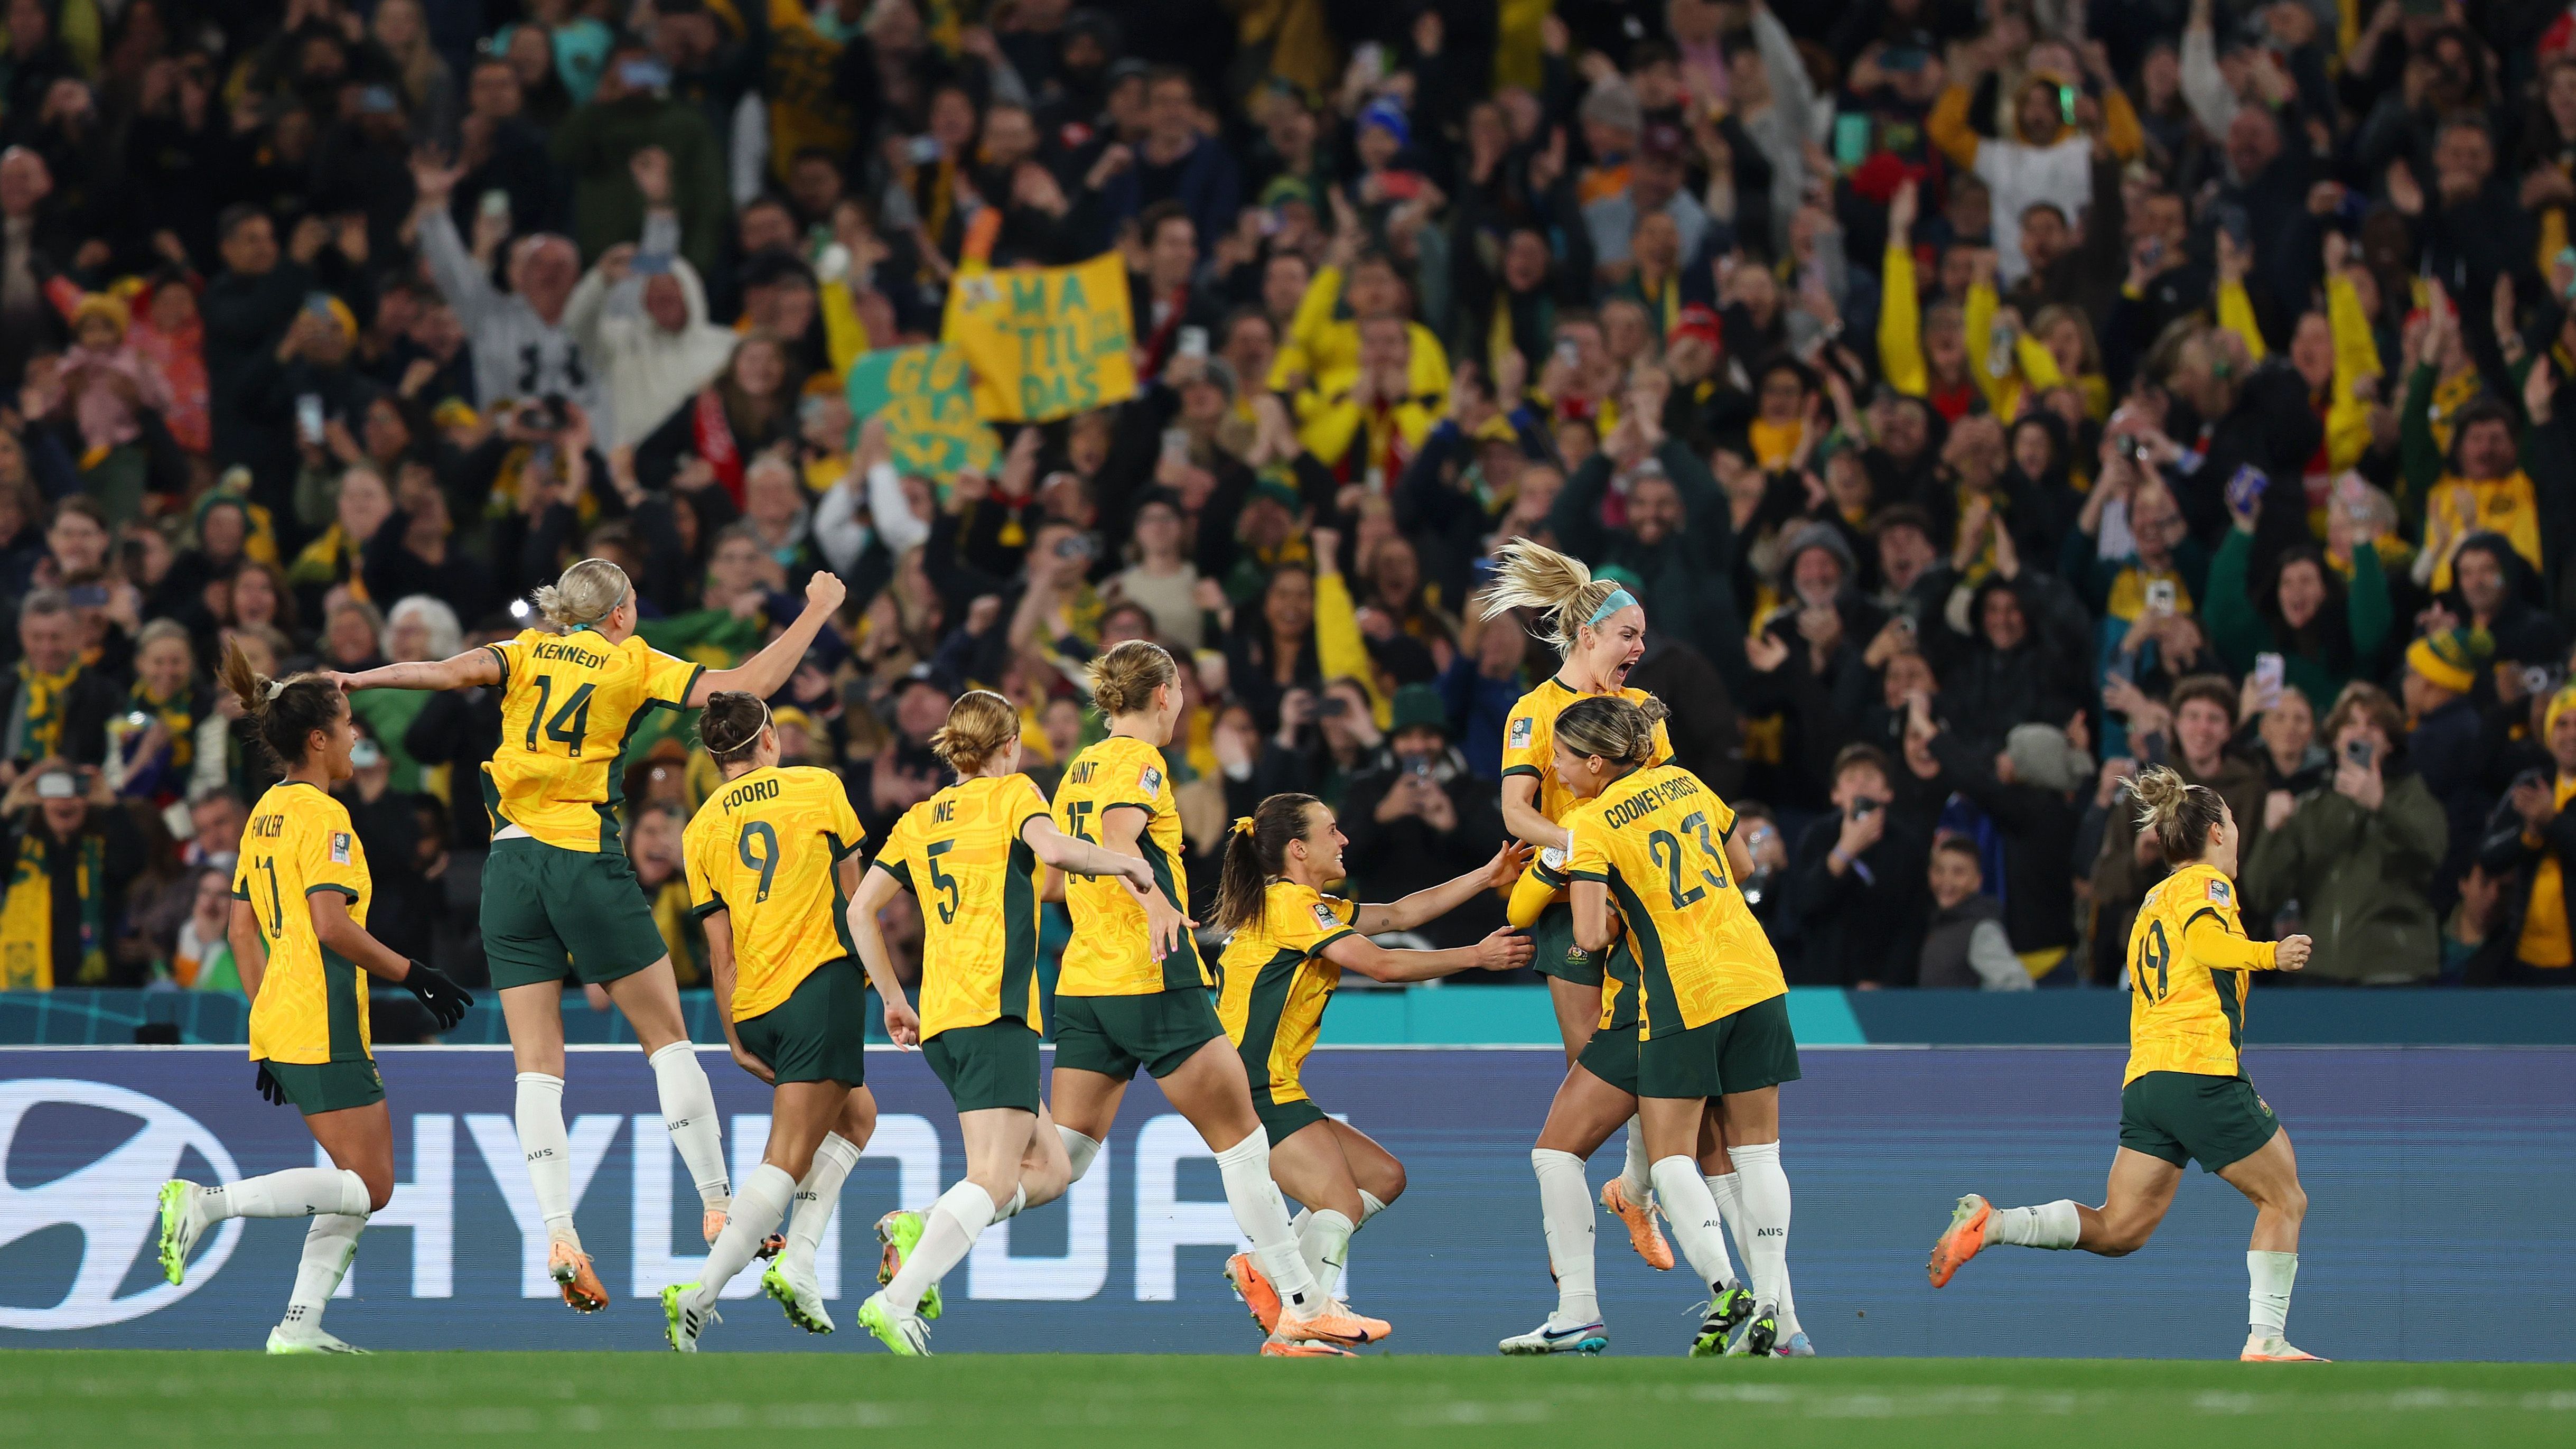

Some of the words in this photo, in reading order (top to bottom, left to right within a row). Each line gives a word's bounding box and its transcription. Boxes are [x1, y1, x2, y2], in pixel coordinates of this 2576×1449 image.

[1012, 274, 1088, 315] MA
[1019, 323, 1082, 372] TIL
[1021, 365, 1100, 419] DAS
[533, 642, 611, 670] KENNEDY
[526, 675, 597, 757] 14
[723, 779, 779, 816] FOORD
[930, 800, 956, 829] INE
[1604, 776, 1698, 829] COONEY-CROSS
[738, 821, 780, 904] 9
[927, 838, 959, 924] 5
[1649, 811, 1728, 911] 23
[255, 855, 282, 939] 11
[2137, 919, 2170, 1007] 19
[668, 1119, 689, 1131] AUS
[528, 1148, 553, 1162] AUS
[795, 1192, 817, 1201] AUS
[1757, 1228, 1783, 1237] AUS
